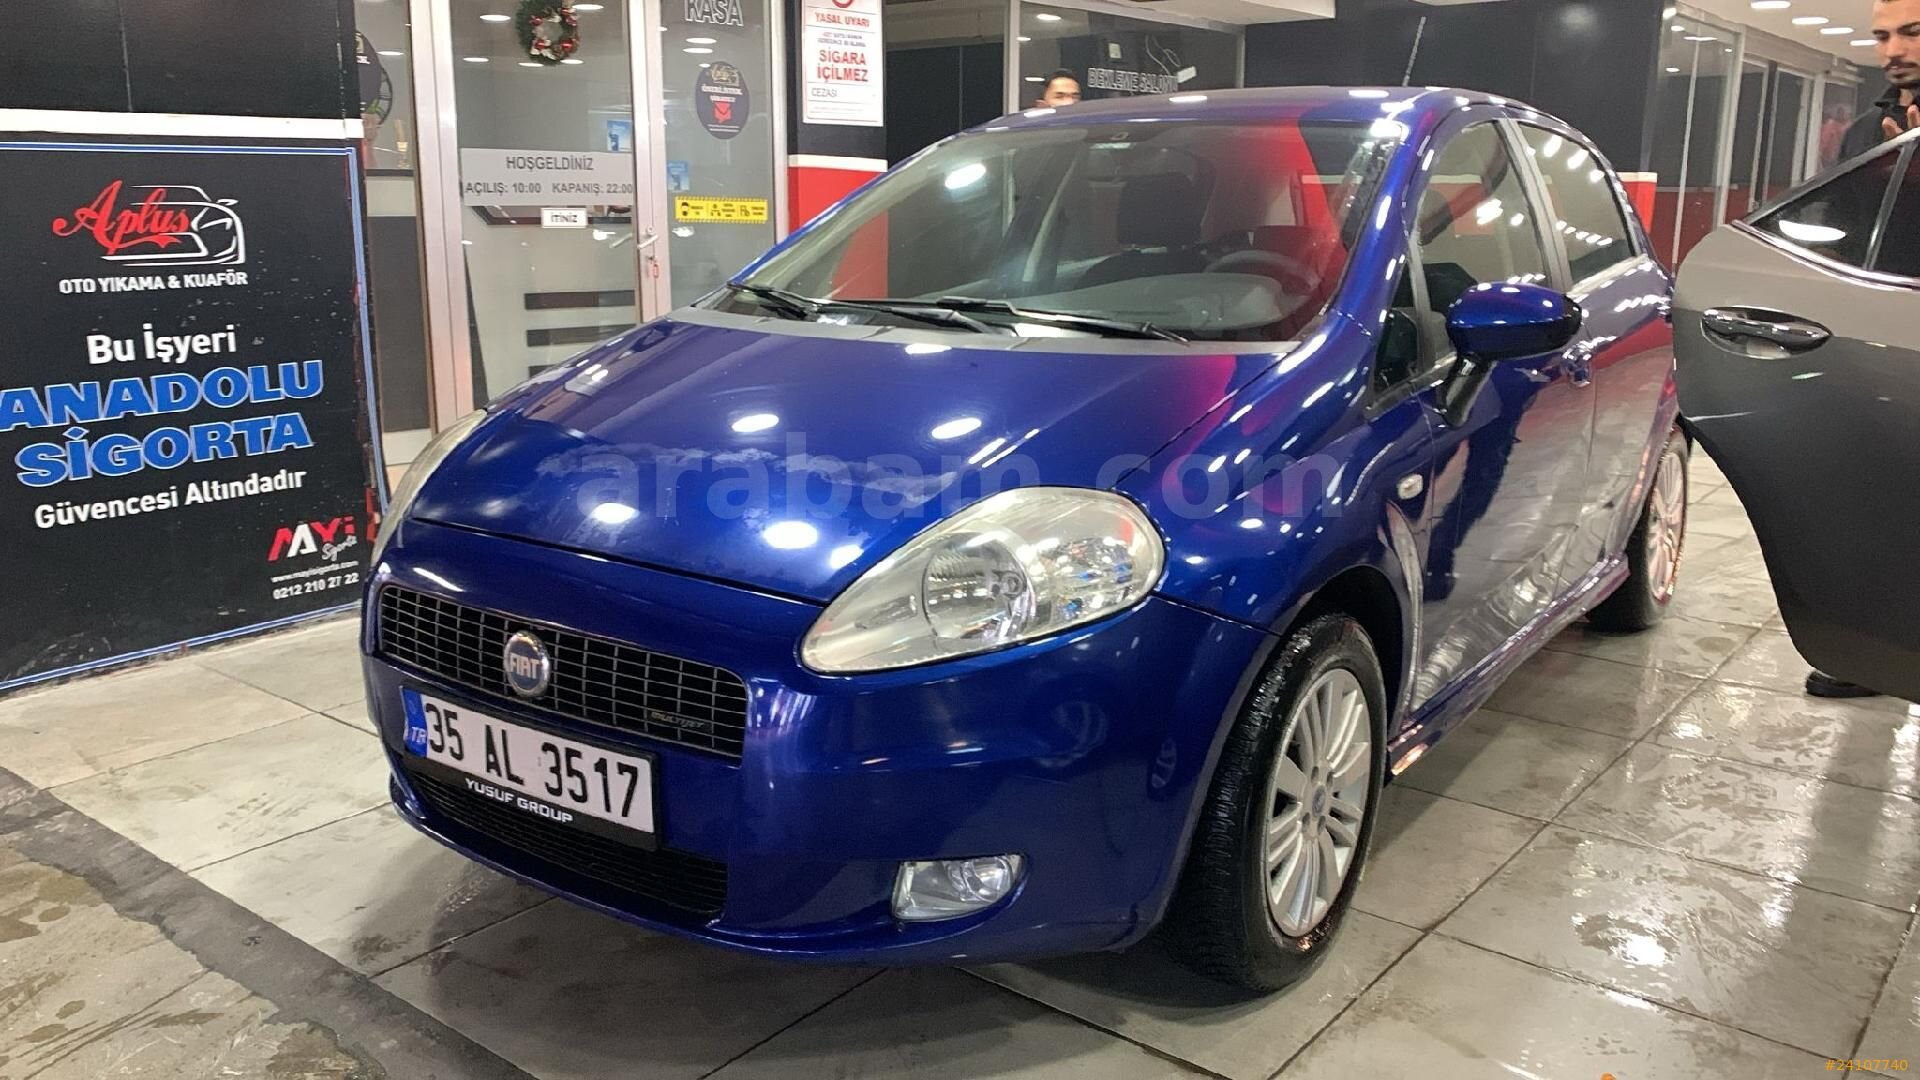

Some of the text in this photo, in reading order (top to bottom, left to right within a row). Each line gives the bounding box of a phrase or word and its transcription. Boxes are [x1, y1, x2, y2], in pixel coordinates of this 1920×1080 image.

[684, 0, 744, 26] KASA
[815, 12, 870, 28] YASAL UYARI
[819, 46, 867, 66] SİGARA
[816, 63, 869, 83] İÇİLMEZ
[506, 155, 594, 172] HOŞGELDİNİZ
[465, 182, 633, 197] AÇILIŞ: 10:00 KAPANIŞ: 22:00
[52, 179, 190, 255] Aplus
[59, 268, 248, 294] OTO YIKAMA & KUAFÖR
[86, 323, 236, 364] Bu İşyeri
[0, 360, 323, 433] ANADOLU
[14, 412, 314, 487] SİGORTA
[34, 468, 307, 529] Güvencesi Altındadır
[273, 572, 360, 599] 0212 210 27 22
[509, 651, 540, 680] FIAT
[411, 726, 427, 744] TR
[425, 702, 640, 818] 35 AL 3517
[465, 777, 574, 824] YUSUF GROUP
